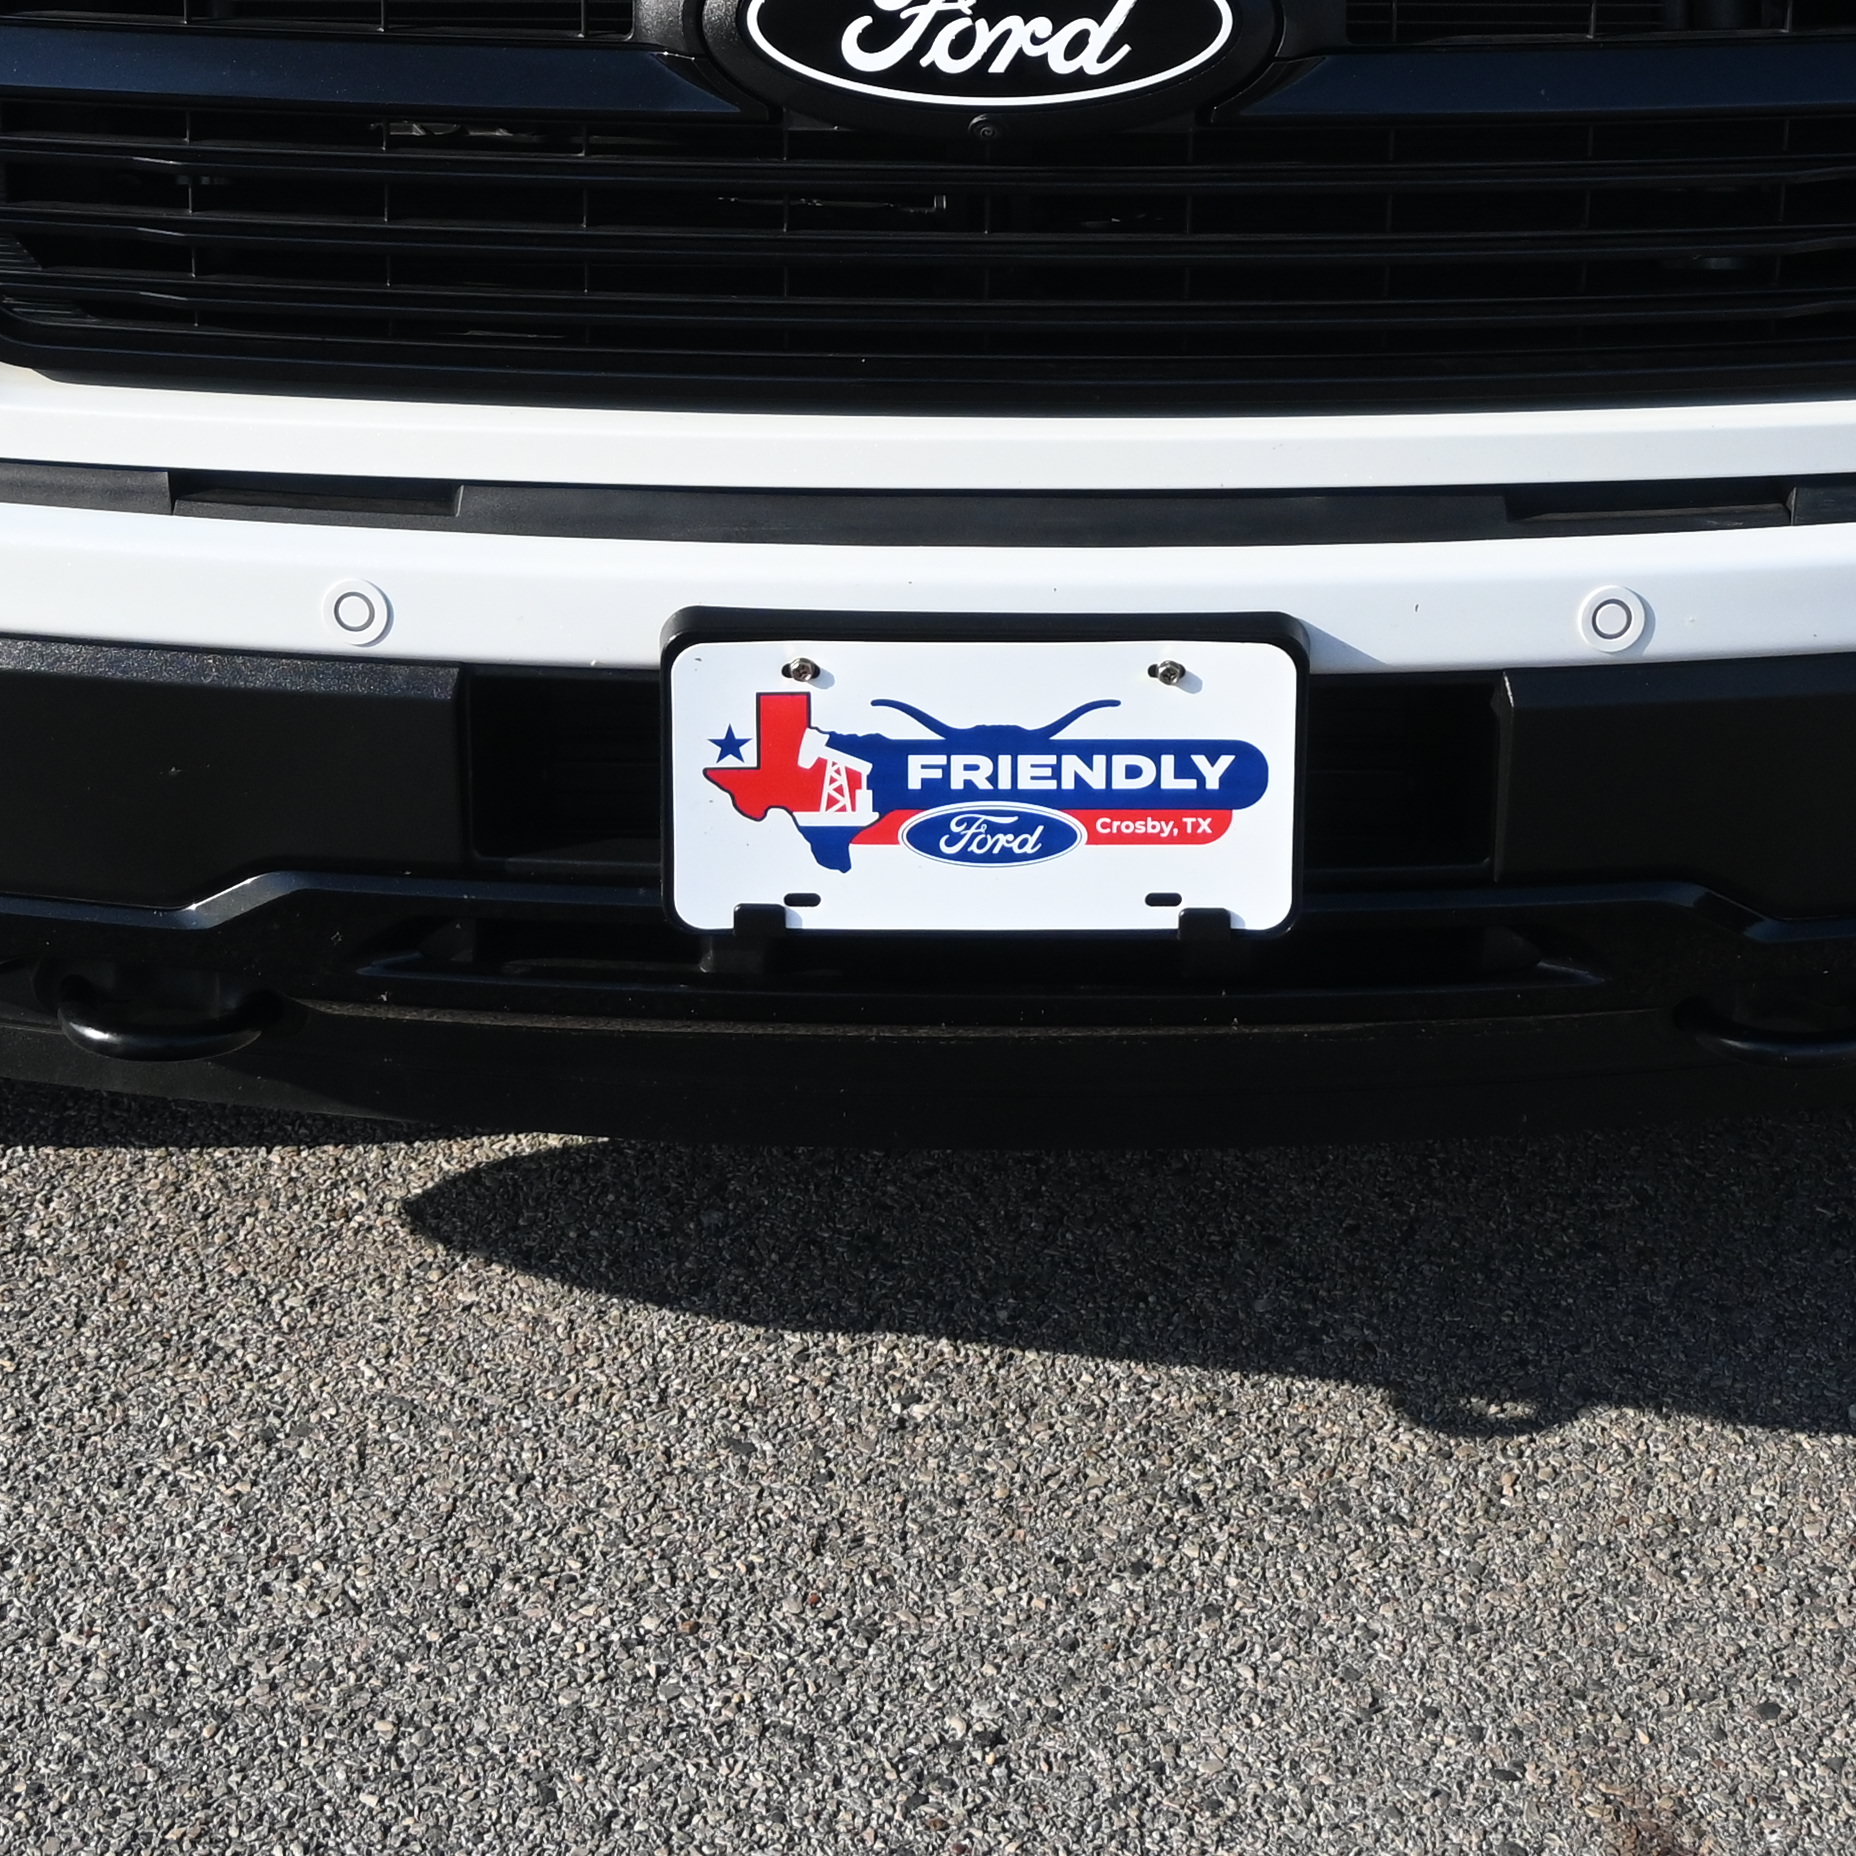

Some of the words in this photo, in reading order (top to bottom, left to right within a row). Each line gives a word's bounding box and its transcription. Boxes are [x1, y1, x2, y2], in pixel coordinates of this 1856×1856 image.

[907, 754, 1237, 790] FRIENDLY
[939, 813, 1045, 855] Ford
[1095, 817, 1179, 838] Crosby,
[1182, 817, 1213, 834] TX
